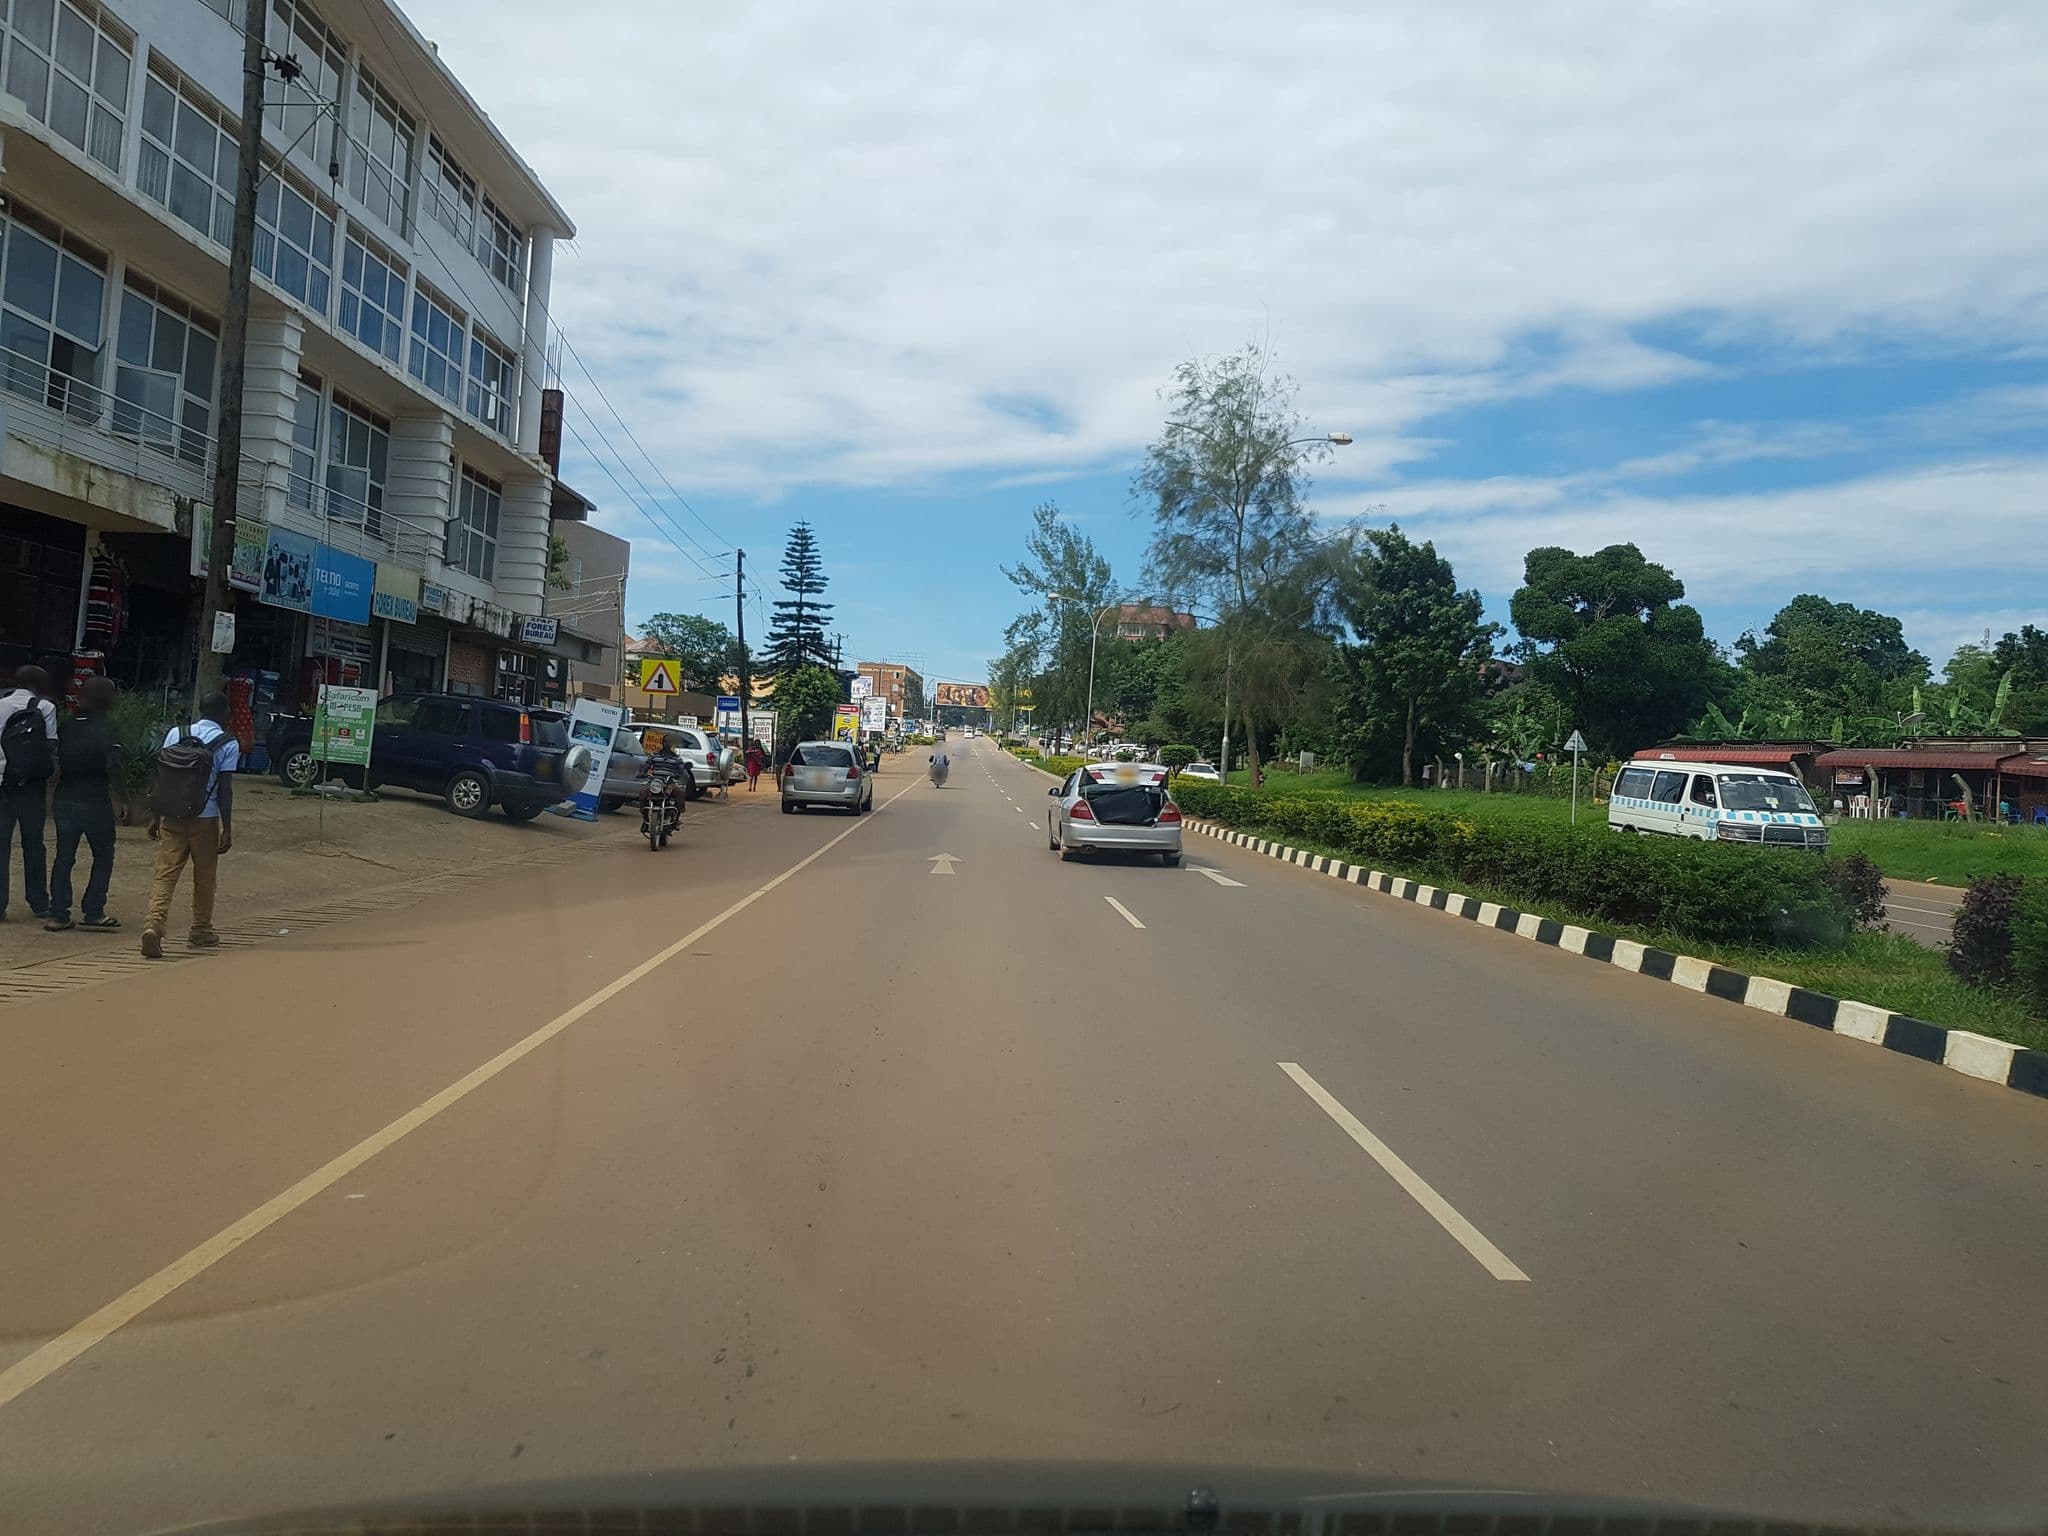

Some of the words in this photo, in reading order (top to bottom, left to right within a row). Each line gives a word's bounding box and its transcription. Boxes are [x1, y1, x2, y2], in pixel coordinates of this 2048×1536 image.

[374, 591, 396, 616] FOREX
[393, 596, 417, 621] BUREAU
[526, 621, 554, 632] FOREX
[525, 629, 554, 639] BUREAU
